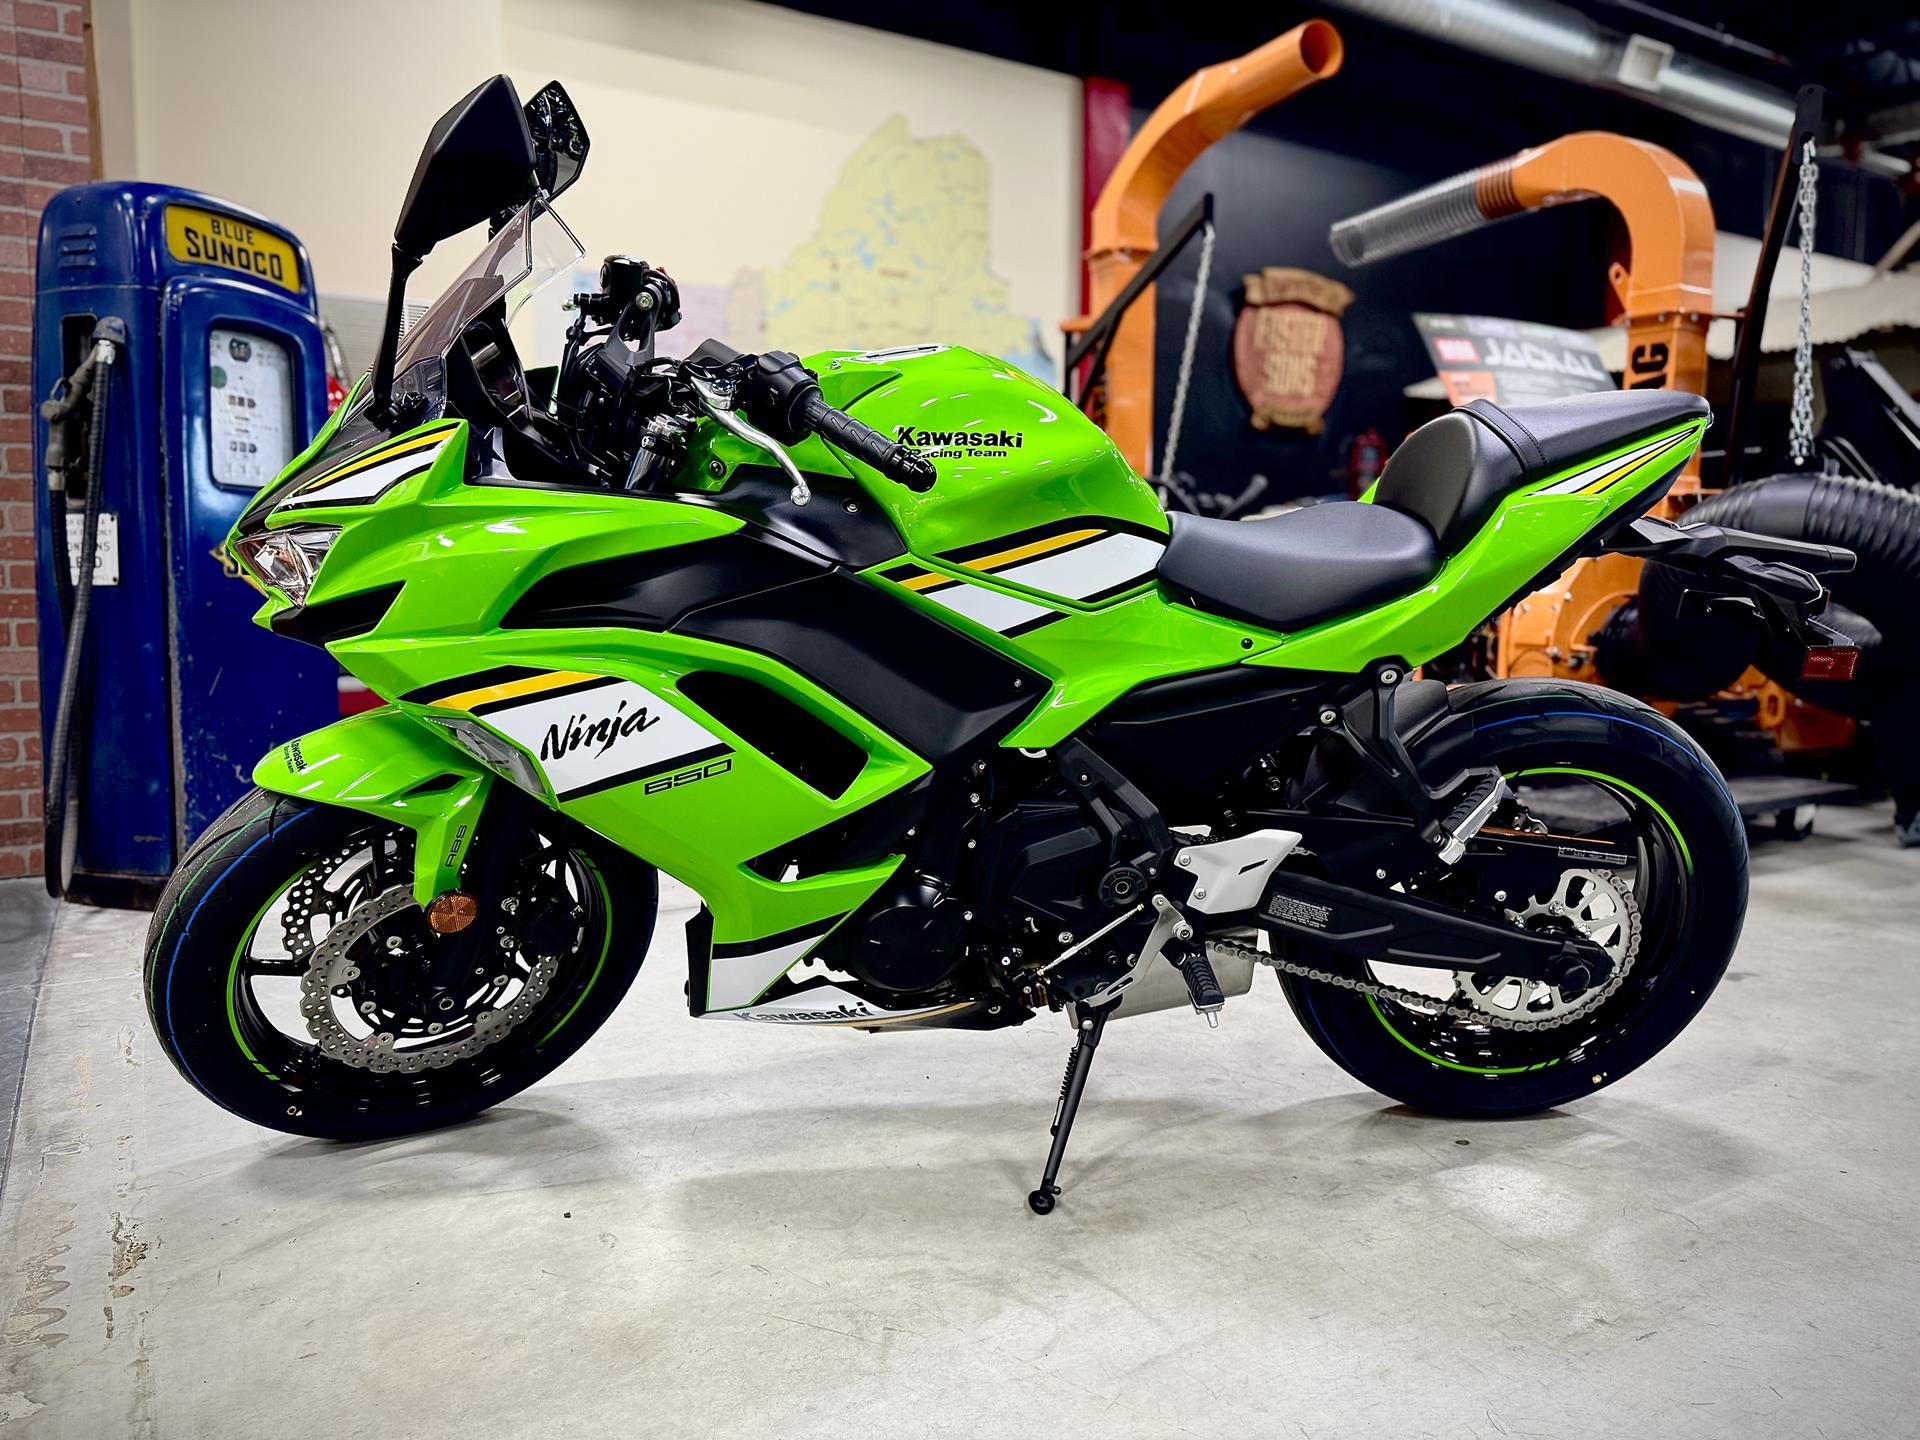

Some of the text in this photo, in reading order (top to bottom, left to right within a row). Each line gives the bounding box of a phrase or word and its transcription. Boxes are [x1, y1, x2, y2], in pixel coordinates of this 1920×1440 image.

[210, 218, 254, 245] BLUE
[184, 226, 283, 282] SUNOCO
[898, 426, 1023, 449] Kawasaki
[966, 448, 1007, 458] Team
[540, 699, 660, 761] Ninja
[644, 758, 732, 796] 650
[445, 824, 468, 868] ABS
[732, 1001, 875, 1022] Kawasaki
